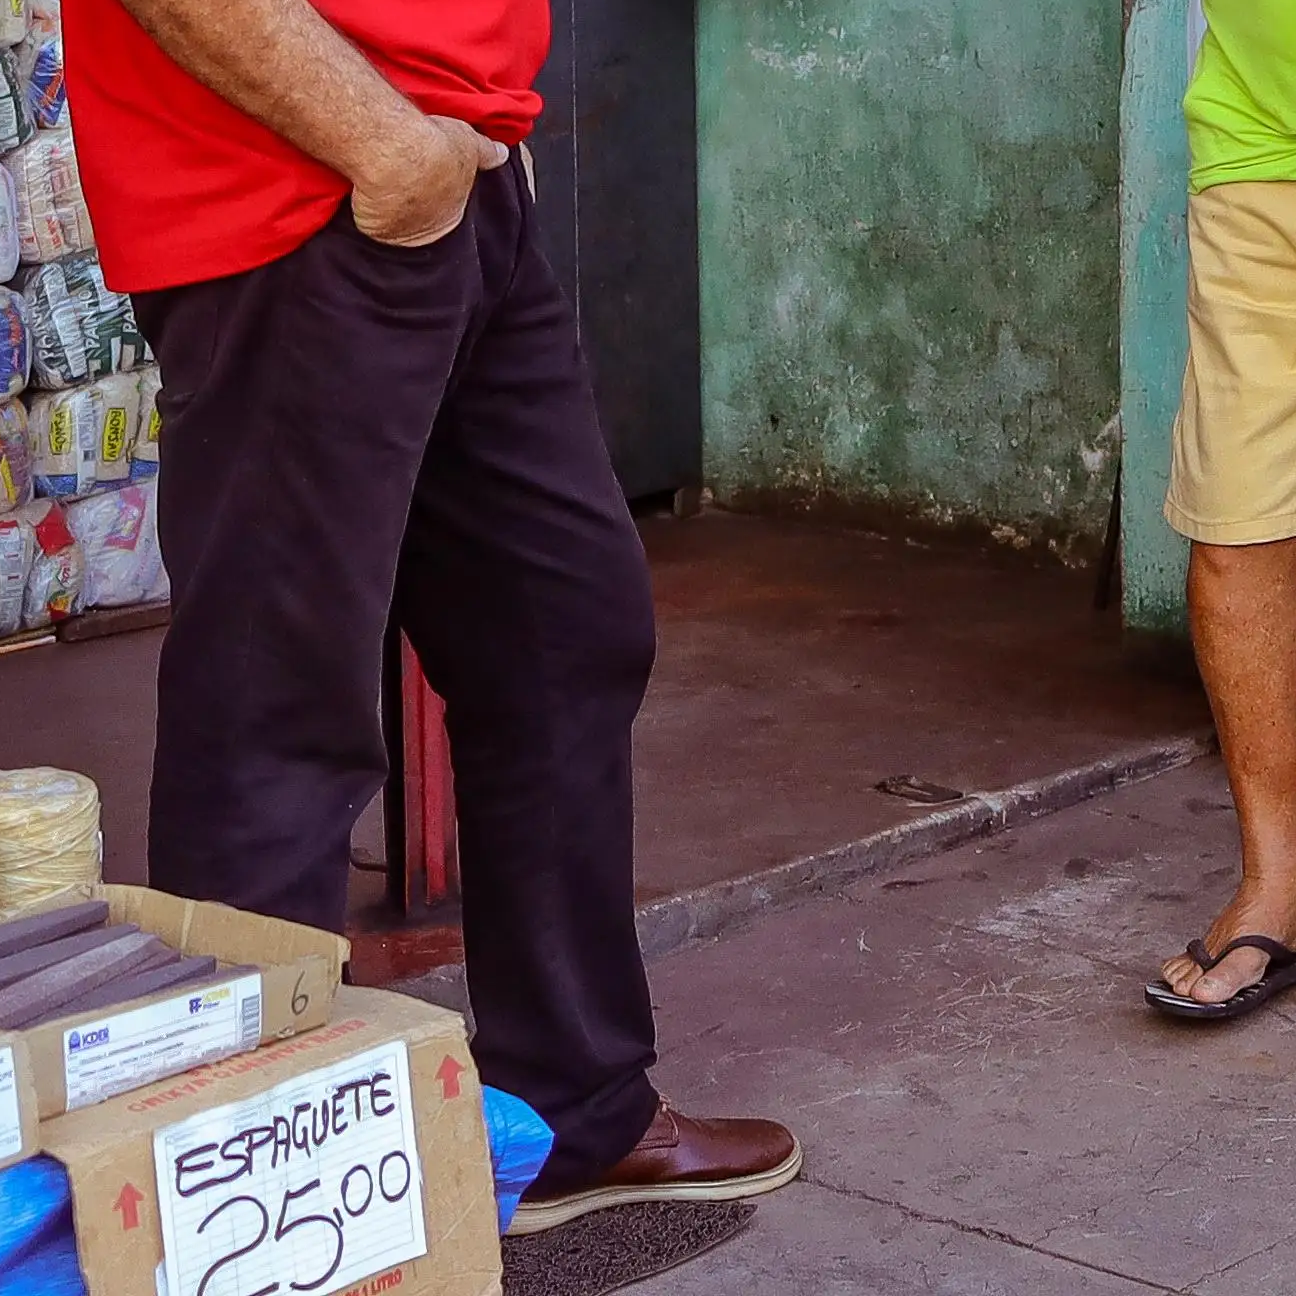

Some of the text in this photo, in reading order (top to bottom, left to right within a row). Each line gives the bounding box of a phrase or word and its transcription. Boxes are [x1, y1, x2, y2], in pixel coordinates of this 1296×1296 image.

[291, 971, 309, 1016] 6
[174, 1072, 396, 1198] ESPAGUETE
[196, 1150, 411, 1296] 25,00
